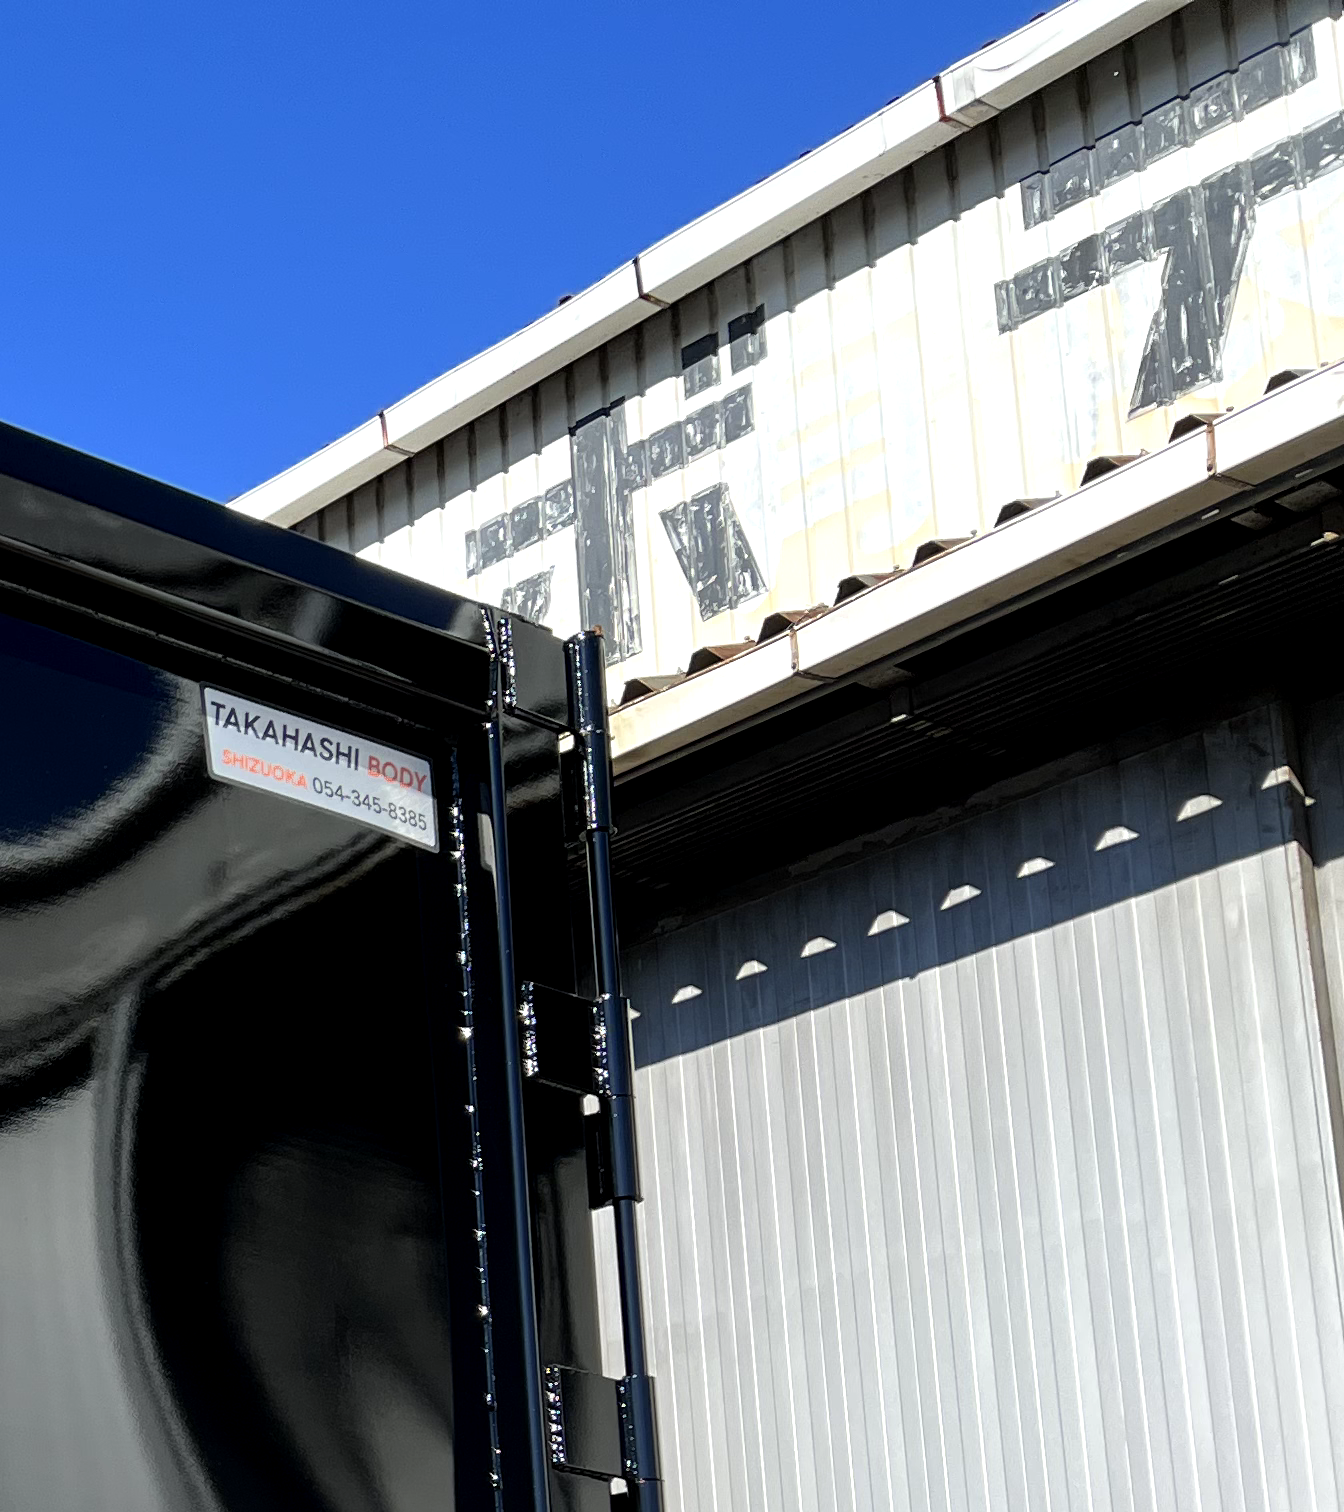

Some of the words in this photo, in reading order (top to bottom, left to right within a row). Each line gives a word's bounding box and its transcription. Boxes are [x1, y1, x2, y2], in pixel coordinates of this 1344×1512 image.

[210, 701, 360, 771] TAKAHASHI
[367, 755, 428, 792] BODY
[222, 749, 308, 790] SHIZUOKA
[312, 777, 427, 831] 054-345-8385
